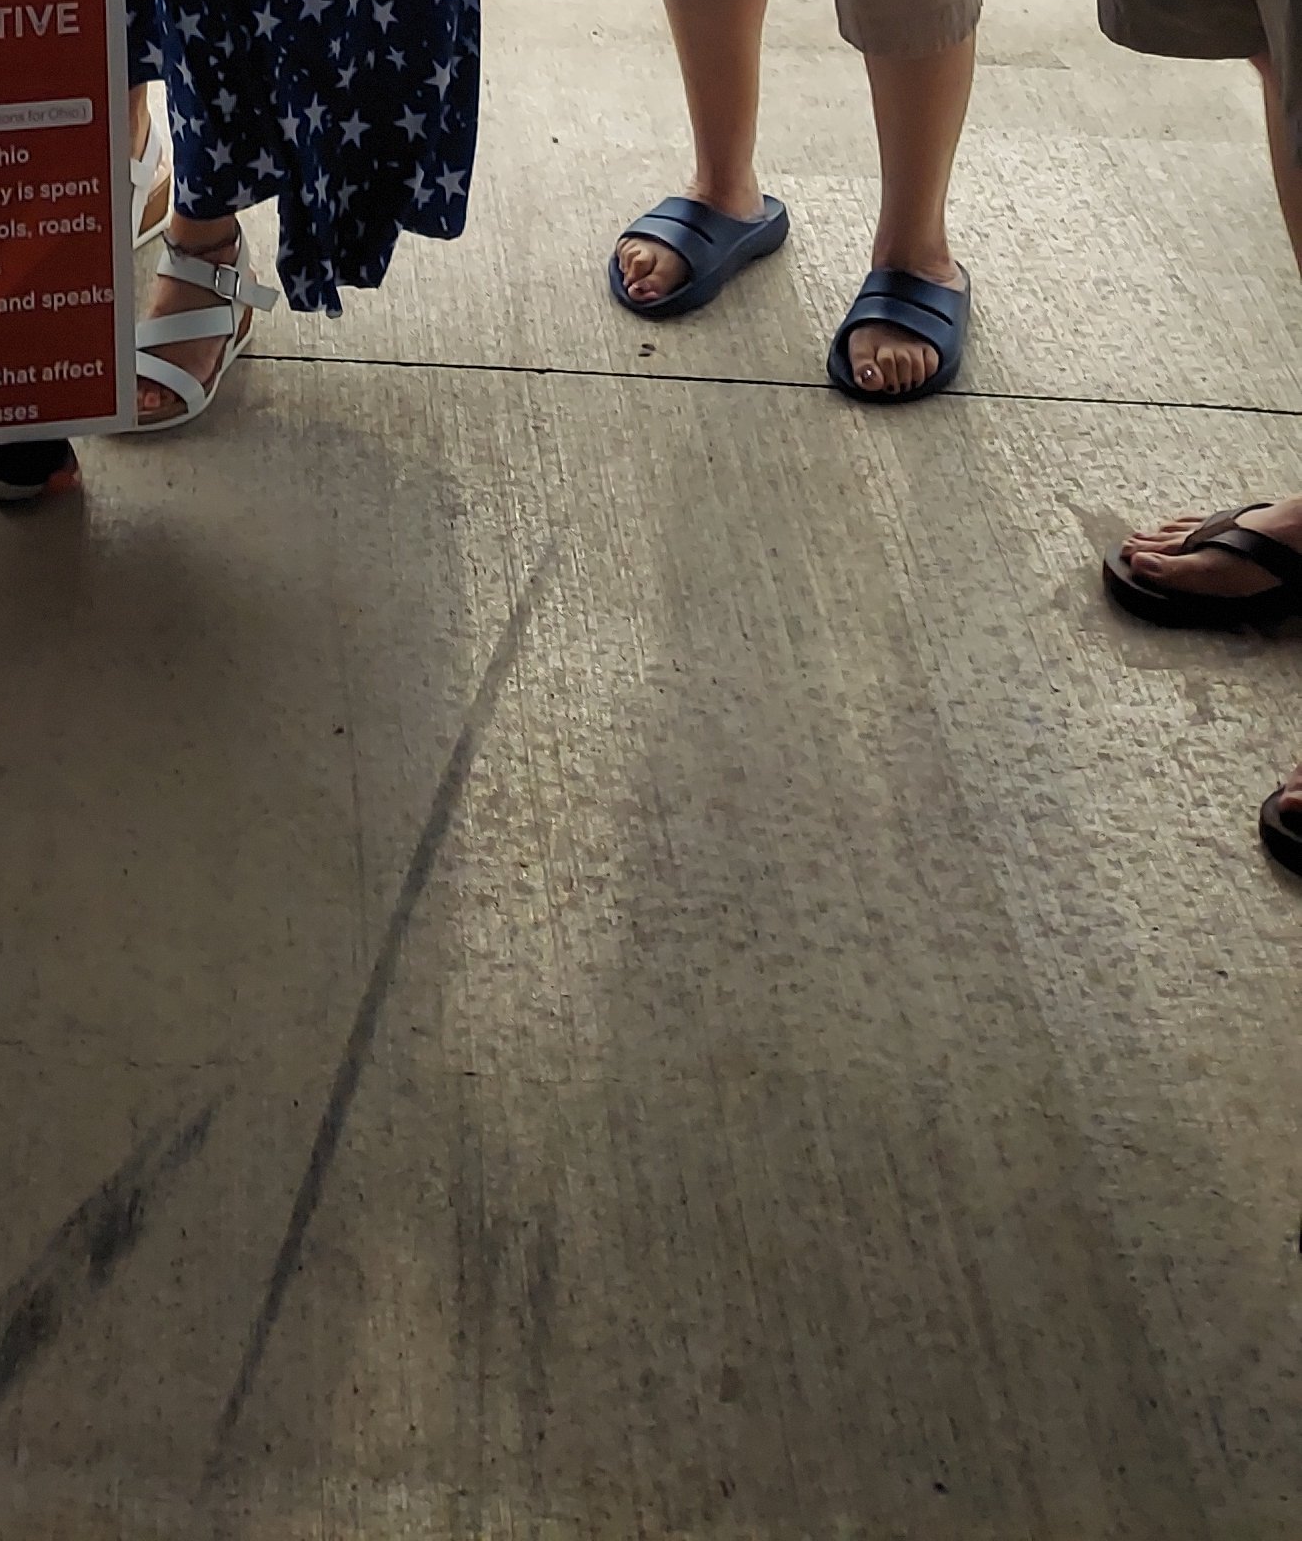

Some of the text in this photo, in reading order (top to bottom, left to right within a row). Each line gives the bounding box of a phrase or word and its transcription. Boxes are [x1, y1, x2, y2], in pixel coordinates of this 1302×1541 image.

[17, 180, 34, 201] is
[40, 177, 99, 203] spent
[39, 212, 102, 235] roads,
[42, 284, 114, 311] speaks
[42, 359, 104, 381] affect
